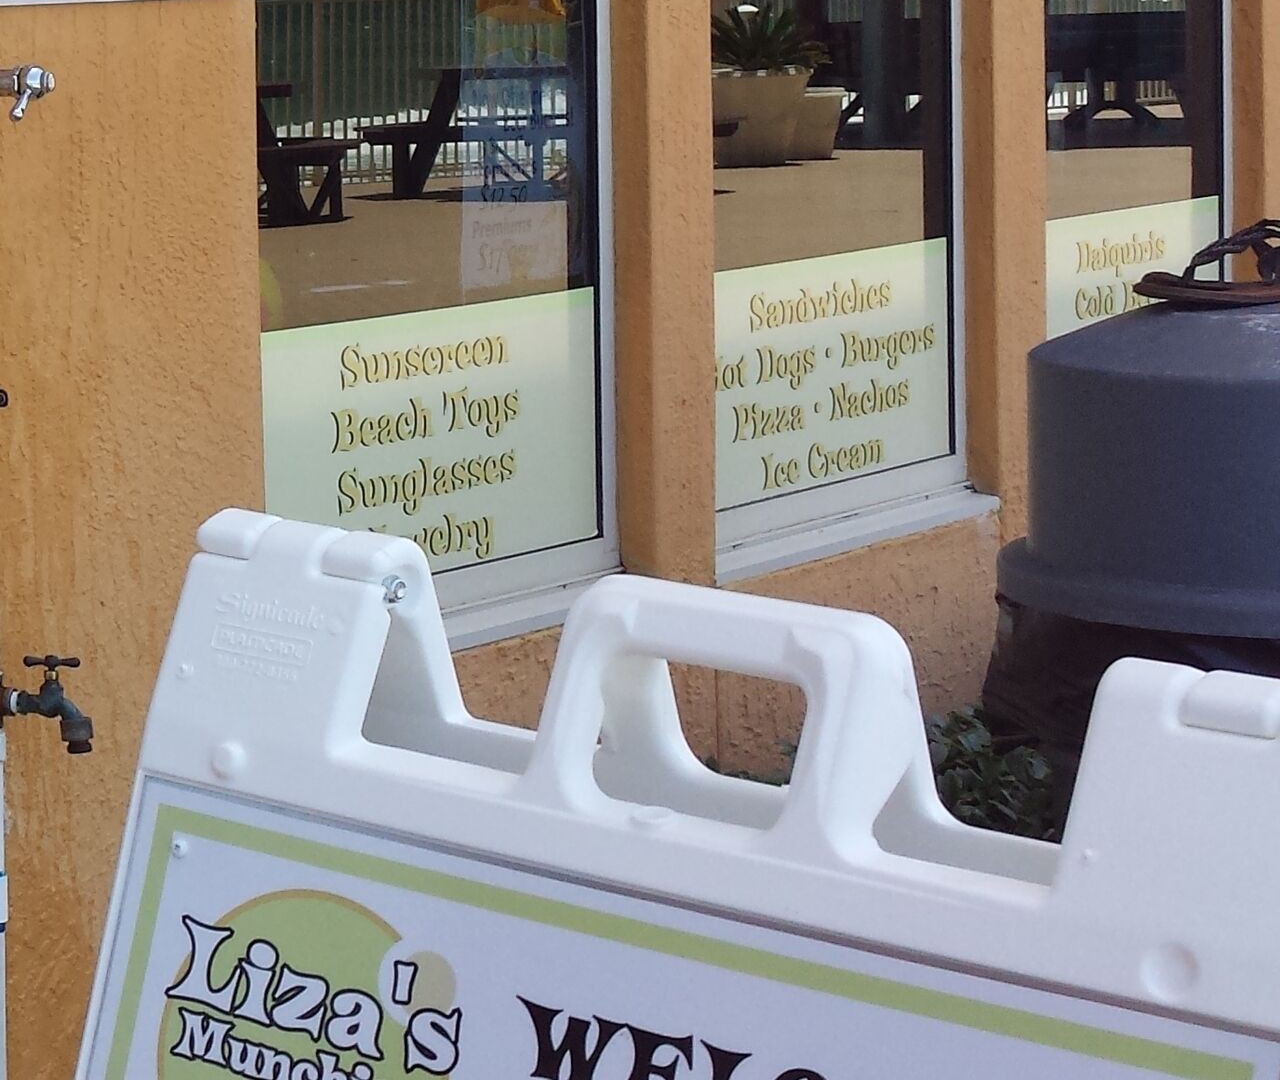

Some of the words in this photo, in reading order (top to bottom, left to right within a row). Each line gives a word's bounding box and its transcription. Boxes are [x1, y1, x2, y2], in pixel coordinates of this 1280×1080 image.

[1076, 231, 1166, 277] Daiquiris
[750, 278, 892, 333] Sandwiches
[1075, 281, 1116, 320] Cold
[340, 335, 509, 390] Sunscreen
[756, 344, 816, 390] Dogs
[840, 323, 935, 370] Burgers
[331, 398, 434, 454] Beach
[443, 386, 521, 438] Toys
[732, 402, 804, 443] Pizza
[829, 378, 910, 421] Nachos
[337, 448, 516, 517] Sunglasses
[761, 453, 800, 491] Ice
[808, 439, 884, 479] Cream
[215, 591, 326, 631] Signicade
[165, 915, 462, 1076] Liza's
